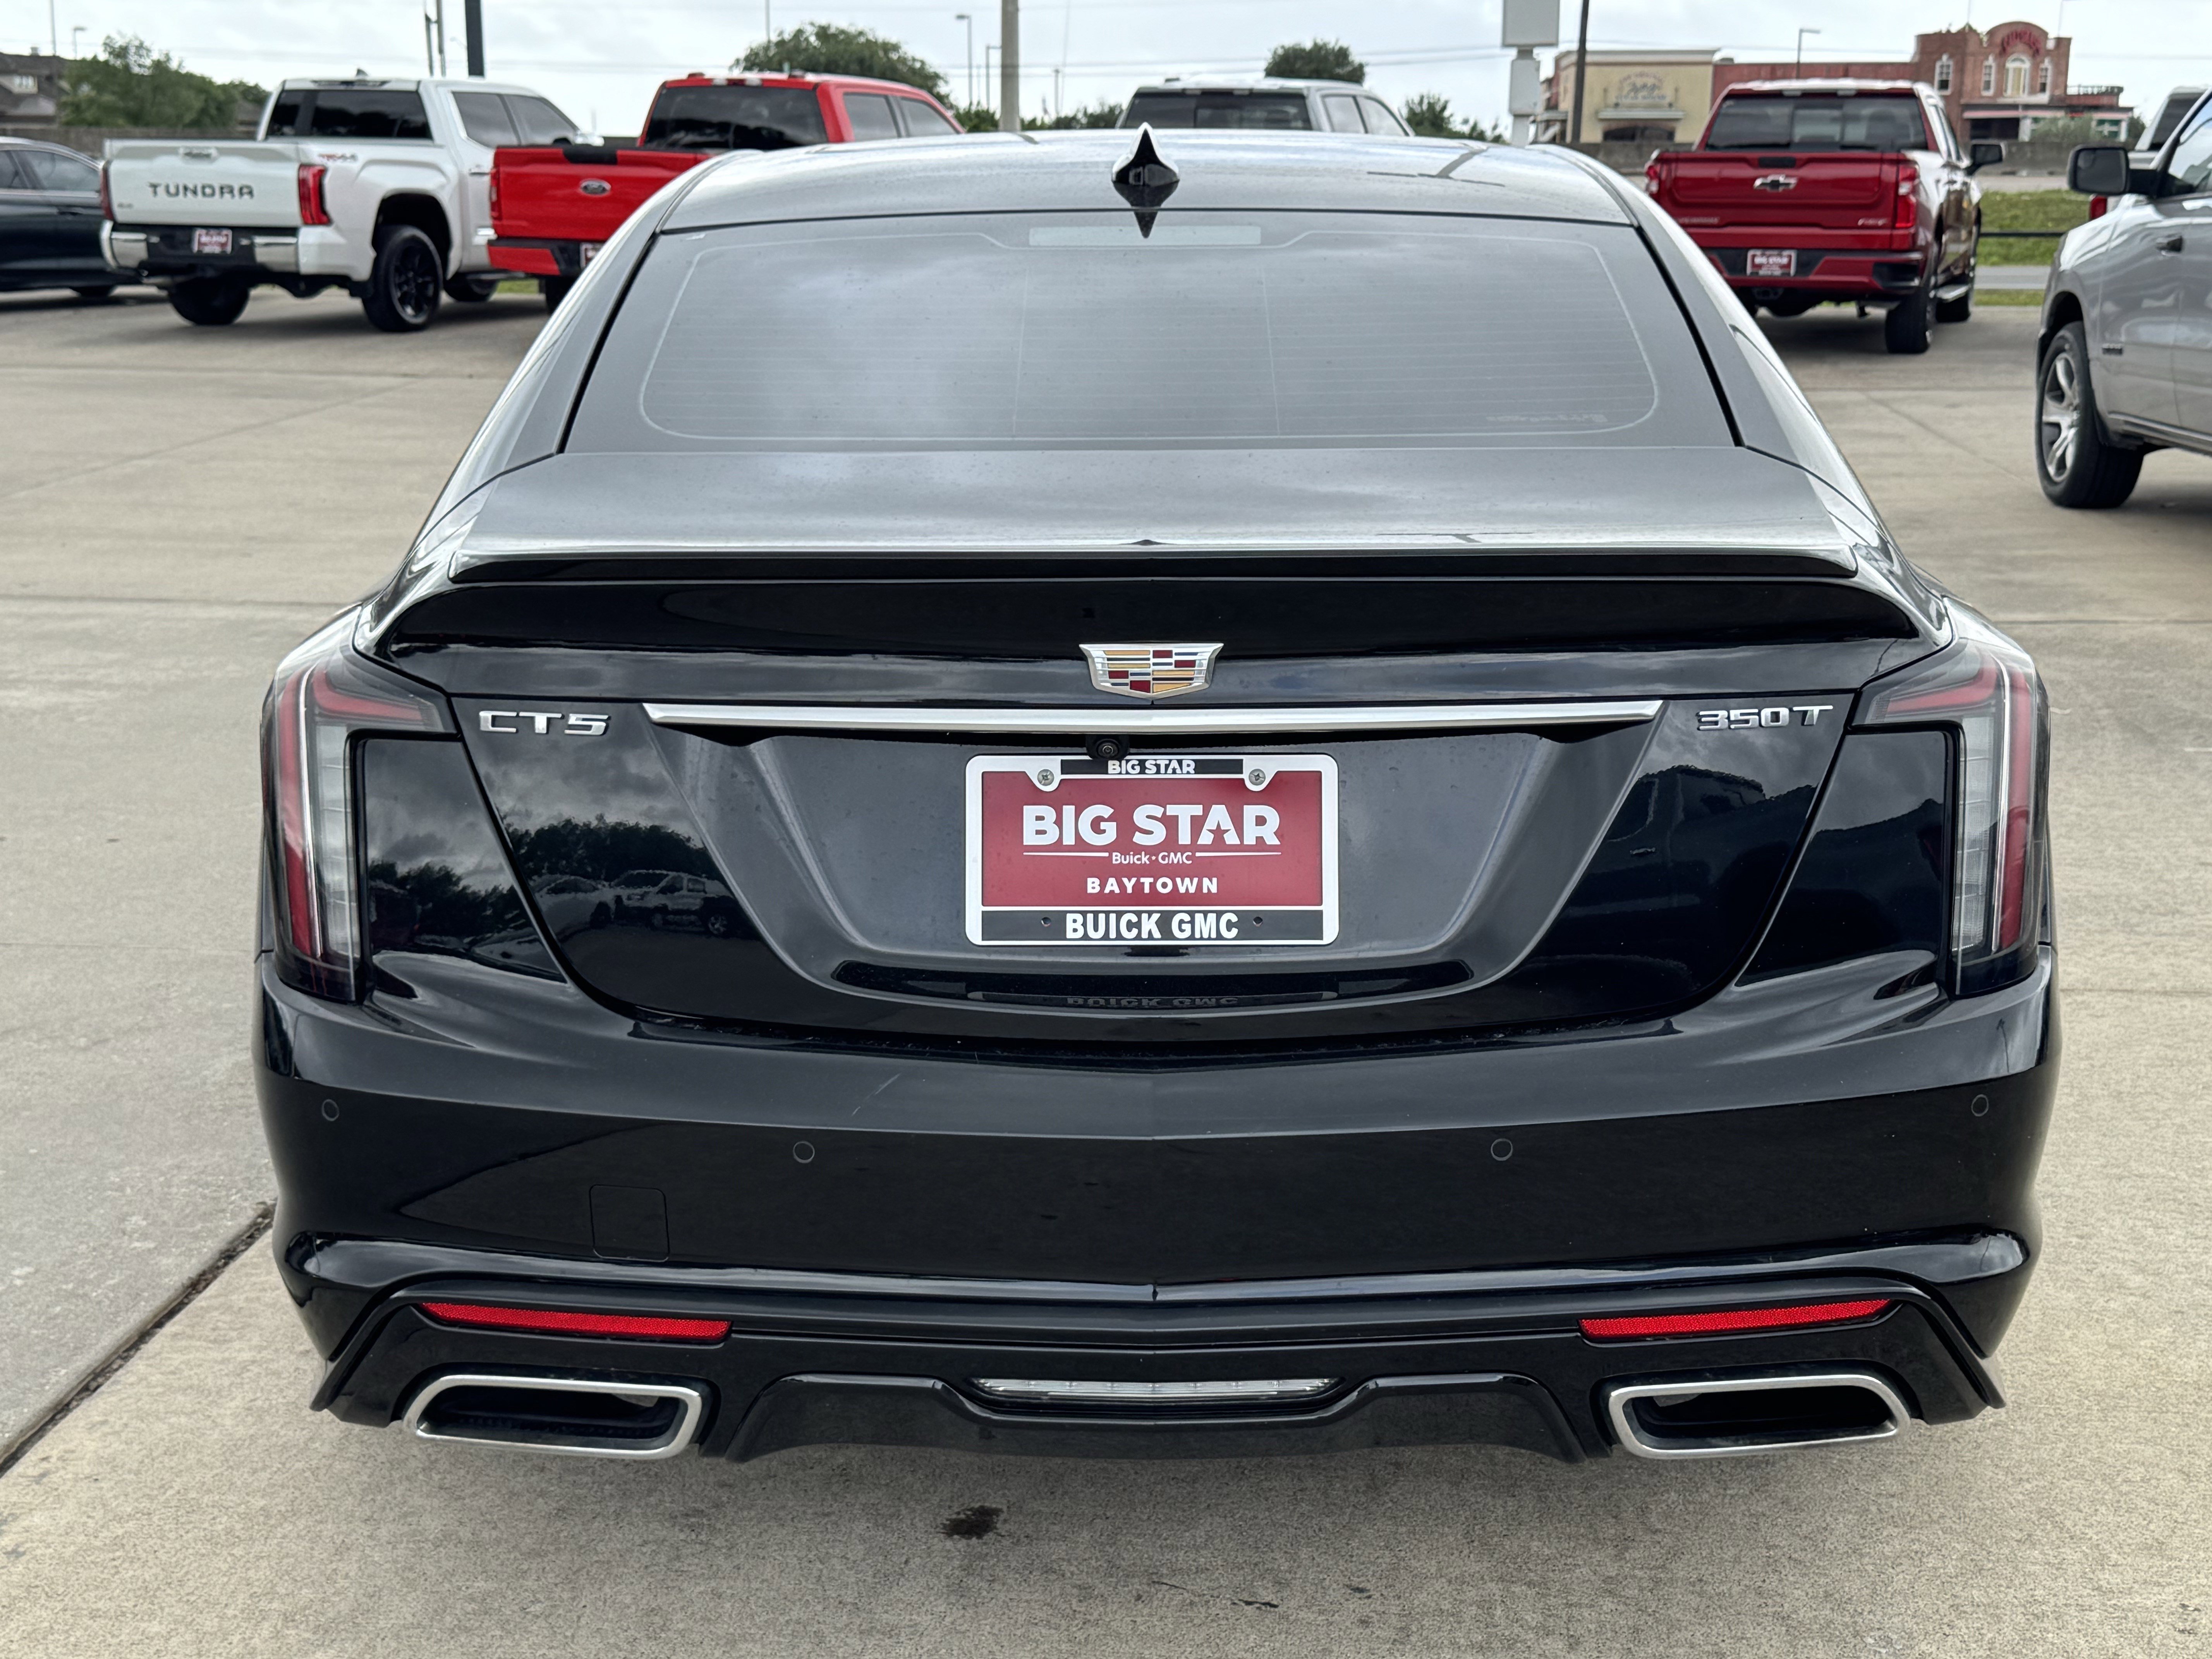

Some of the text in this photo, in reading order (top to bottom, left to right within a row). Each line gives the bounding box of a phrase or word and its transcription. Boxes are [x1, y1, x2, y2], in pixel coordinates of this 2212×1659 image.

[147, 182, 254, 199] TUNDRA
[479, 711, 609, 735] CT5
[1698, 705, 1833, 730] 350T
[1108, 760, 1195, 774] BIG STAR
[1023, 804, 1281, 845] BIG STAR
[1087, 877, 1218, 893] BAYTOWN
[1066, 913, 1238, 939] BUICK GMC
